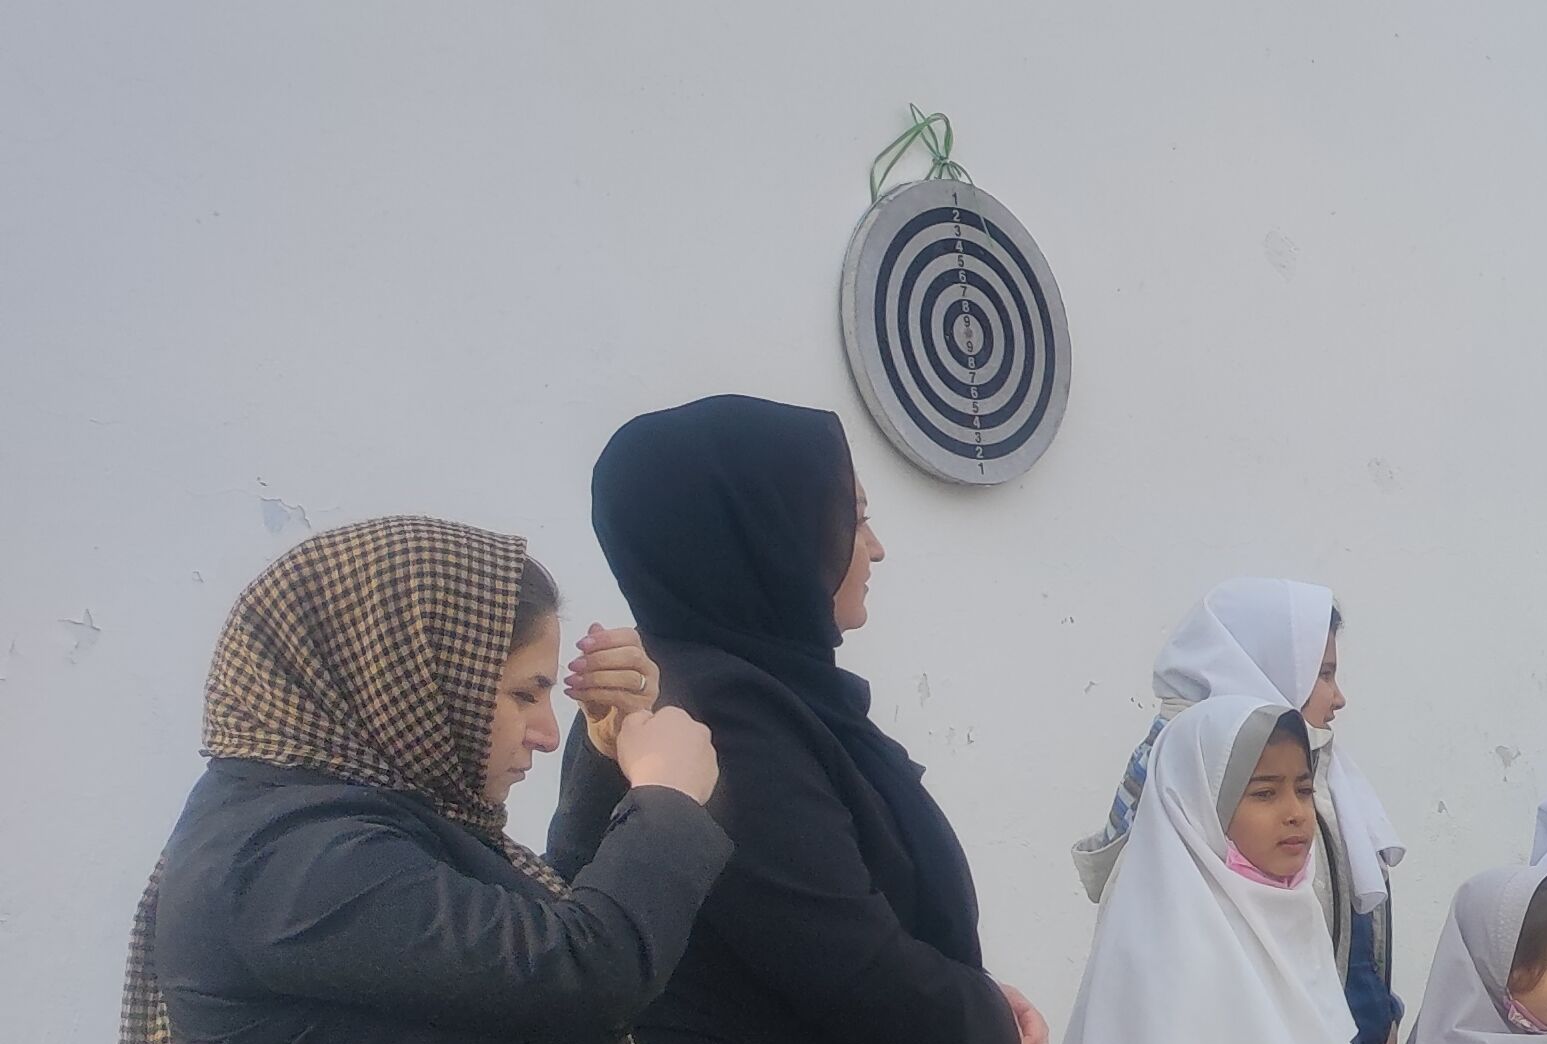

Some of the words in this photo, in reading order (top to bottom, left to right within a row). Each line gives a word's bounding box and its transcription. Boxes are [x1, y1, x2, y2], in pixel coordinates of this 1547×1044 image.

[952, 192, 958, 205] 1
[952, 210, 960, 221] 2
[954, 225, 961, 237] 3
[955, 240, 964, 253] 4
[957, 255, 965, 268] 5
[958, 271, 967, 283] 6
[960, 285, 968, 297] 7
[962, 301, 970, 312] 8
[963, 316, 971, 328] 9
[966, 341, 974, 353] 9
[968, 357, 975, 369] 8
[969, 372, 976, 383] 7
[970, 387, 978, 399] 6
[972, 402, 979, 413] 5
[972, 416, 981, 429] 4
[975, 432, 982, 443] 3
[976, 446, 984, 459] 2
[978, 462, 984, 475] 1
